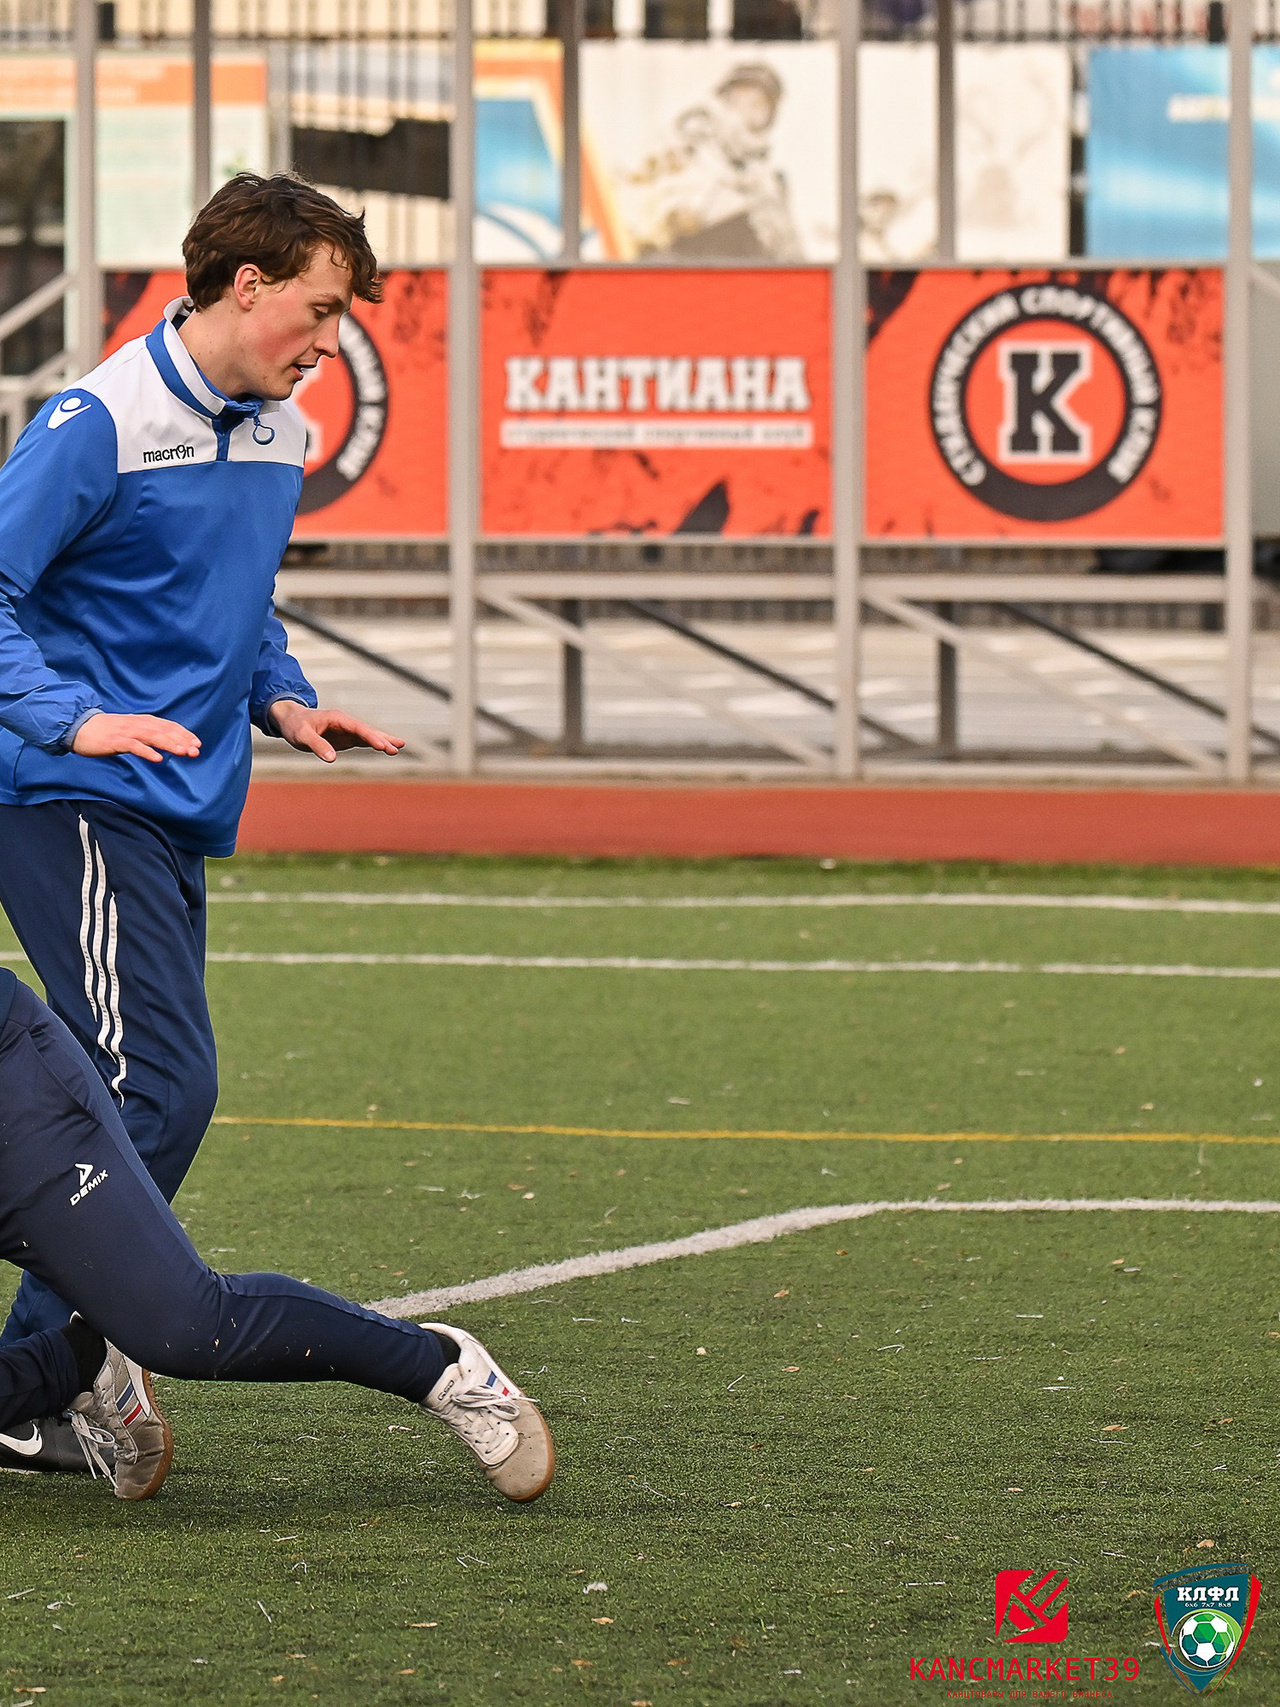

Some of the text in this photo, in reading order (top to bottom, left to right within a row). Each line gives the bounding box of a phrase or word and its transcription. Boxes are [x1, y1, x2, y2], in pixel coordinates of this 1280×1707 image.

[504, 356, 812, 412] КАНТИАНА
[143, 444, 195, 463] macron
[70, 1169, 109, 1206] DEMIX
